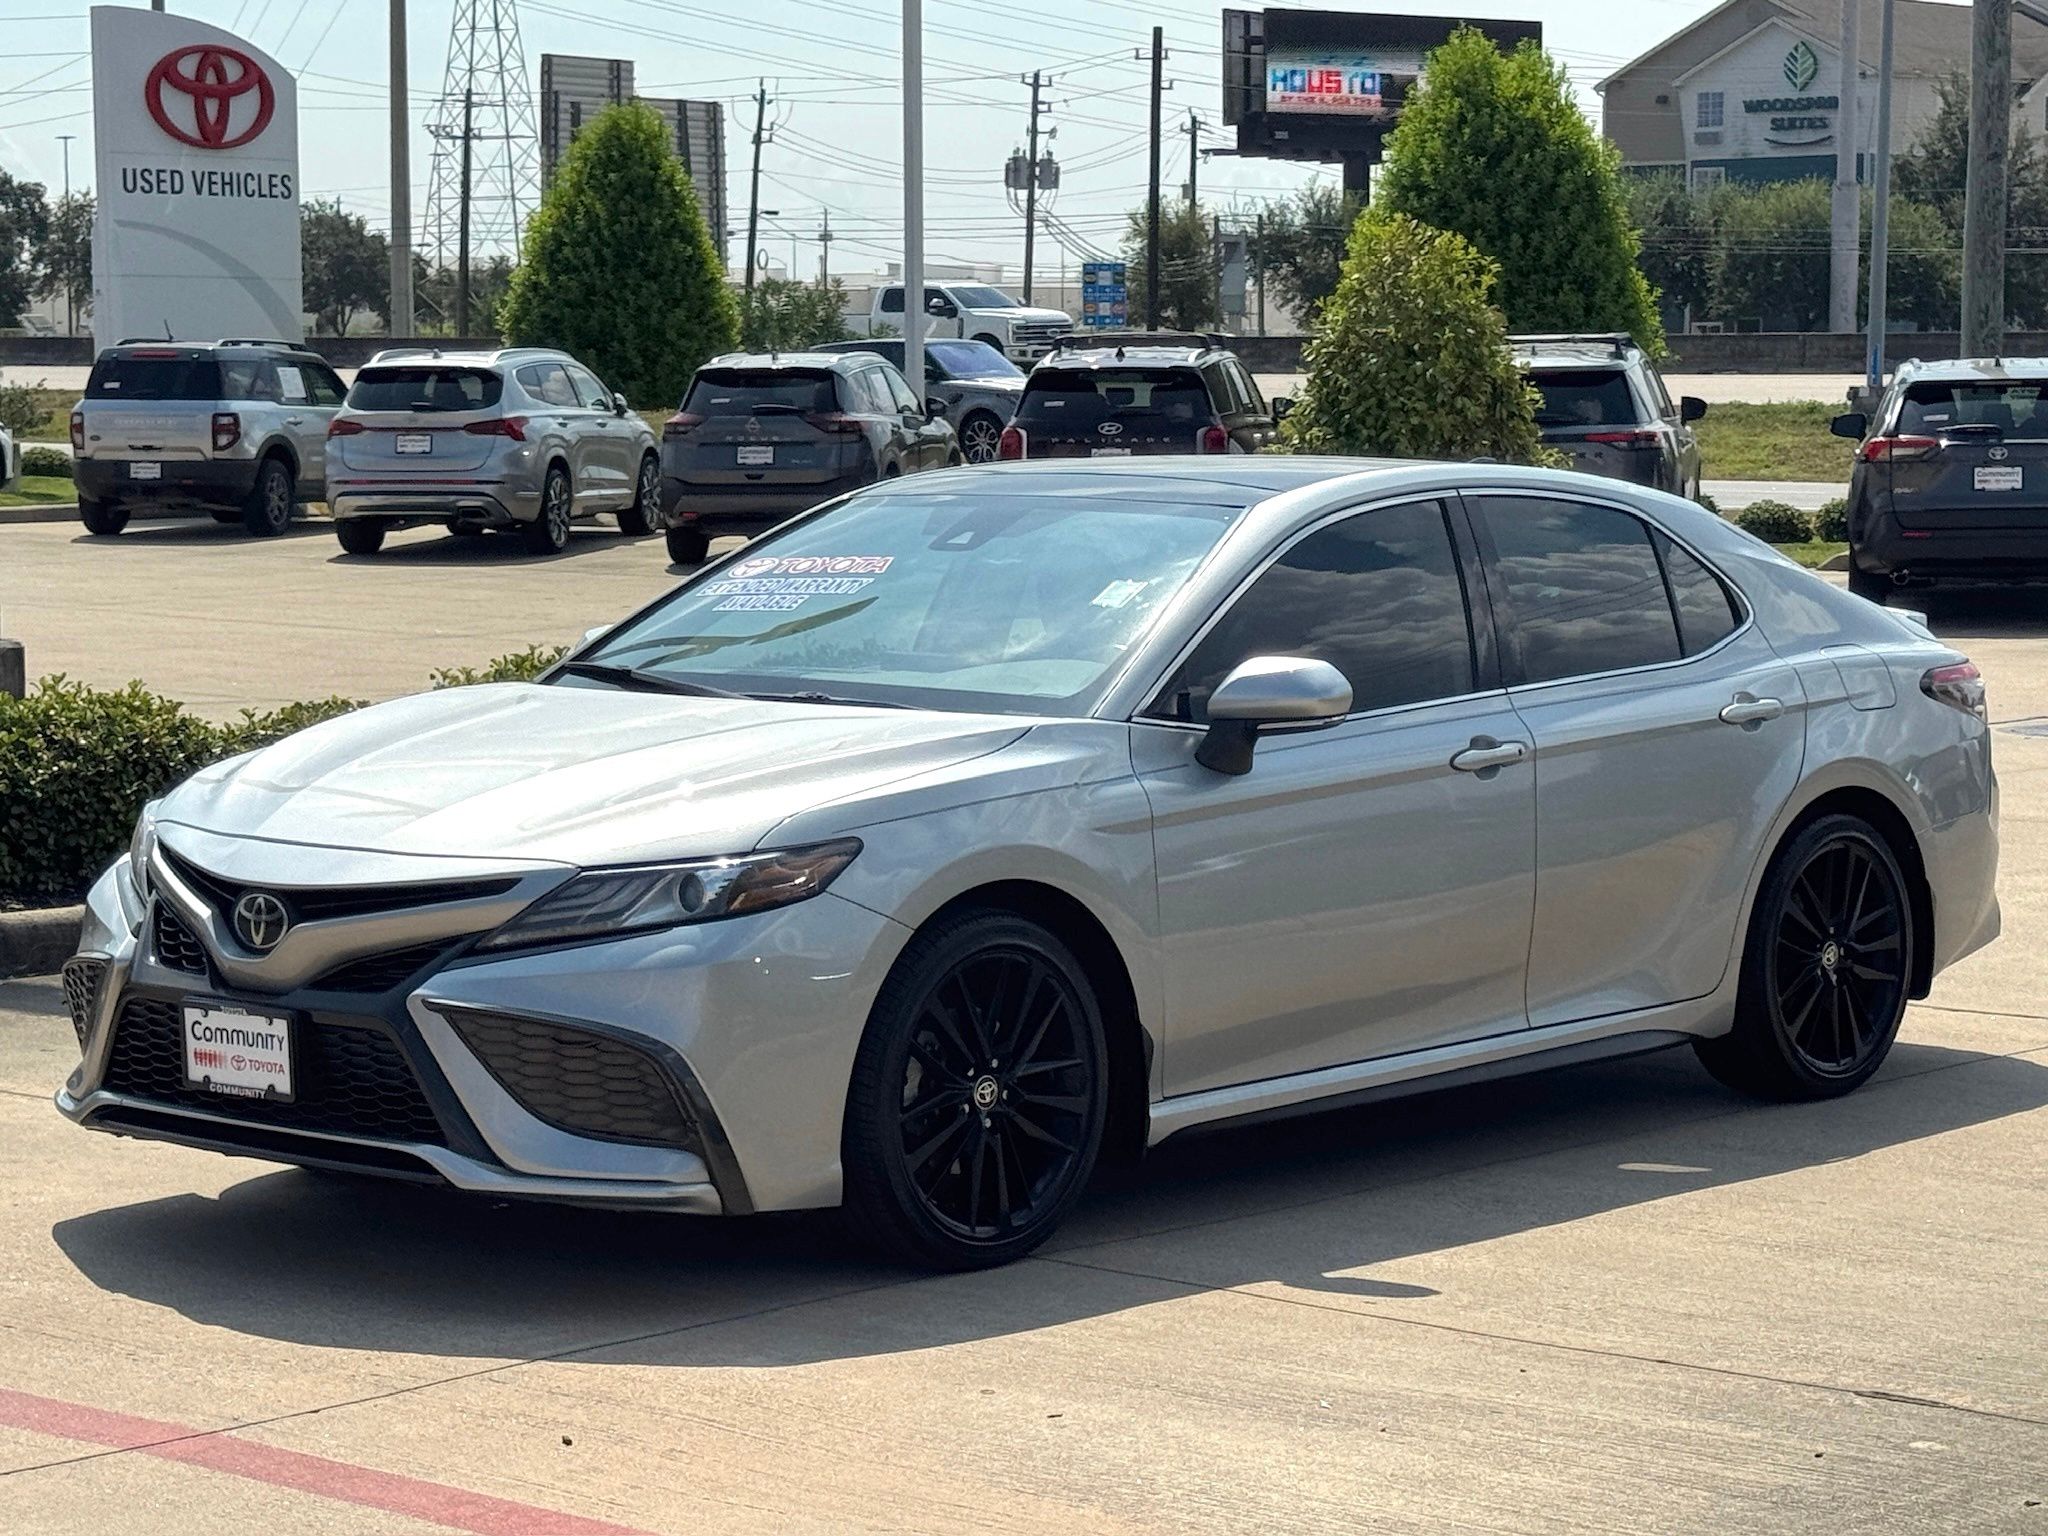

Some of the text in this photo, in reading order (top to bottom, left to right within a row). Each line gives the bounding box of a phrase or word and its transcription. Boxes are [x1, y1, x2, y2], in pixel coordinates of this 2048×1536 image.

[1770, 117, 1829, 131] SUITES
[122, 168, 293, 200] USED VEHICLES
[774, 556, 895, 575] TOYOTA
[247, 1058, 286, 1075] TOYOTA
[209, 1083, 267, 1100] COMMUNITY
